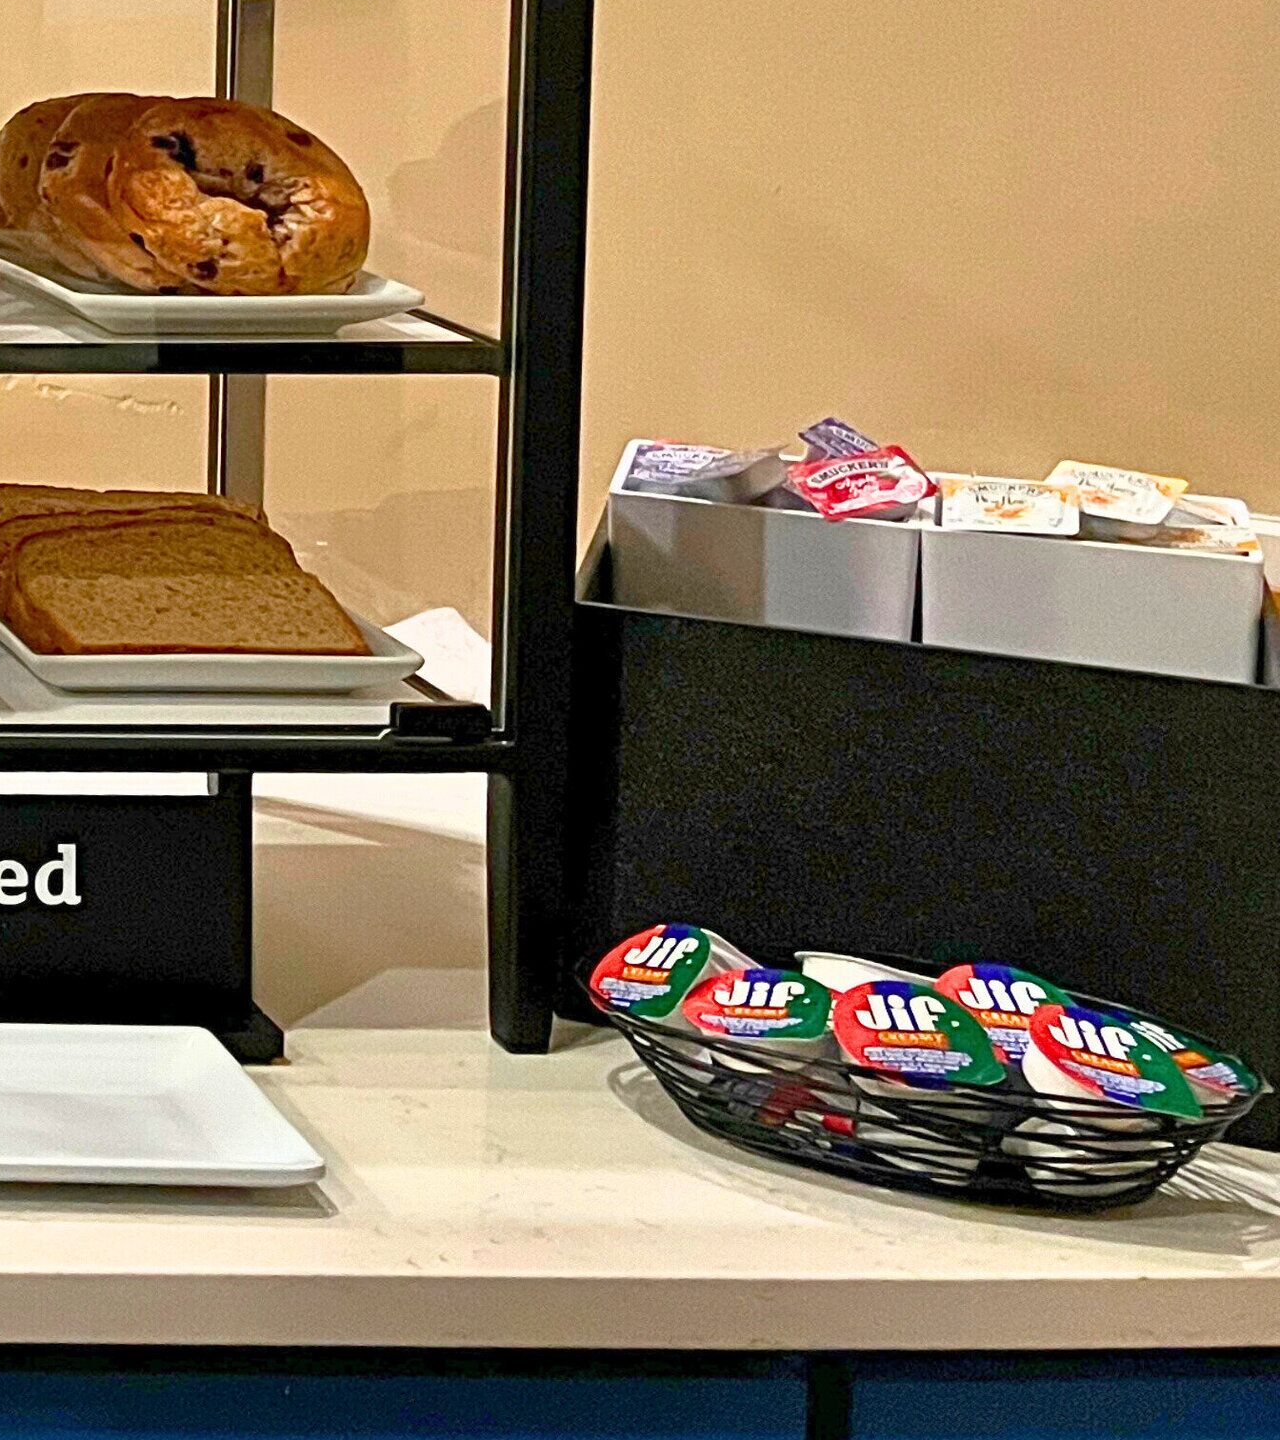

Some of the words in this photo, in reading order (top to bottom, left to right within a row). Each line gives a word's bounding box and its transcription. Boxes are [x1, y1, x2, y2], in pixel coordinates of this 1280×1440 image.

[624, 935, 700, 970] Jif
[714, 980, 806, 1008] Jif
[854, 994, 947, 1032] Jif
[958, 977, 1048, 1015] Jif
[1048, 1013, 1139, 1061] Jif
